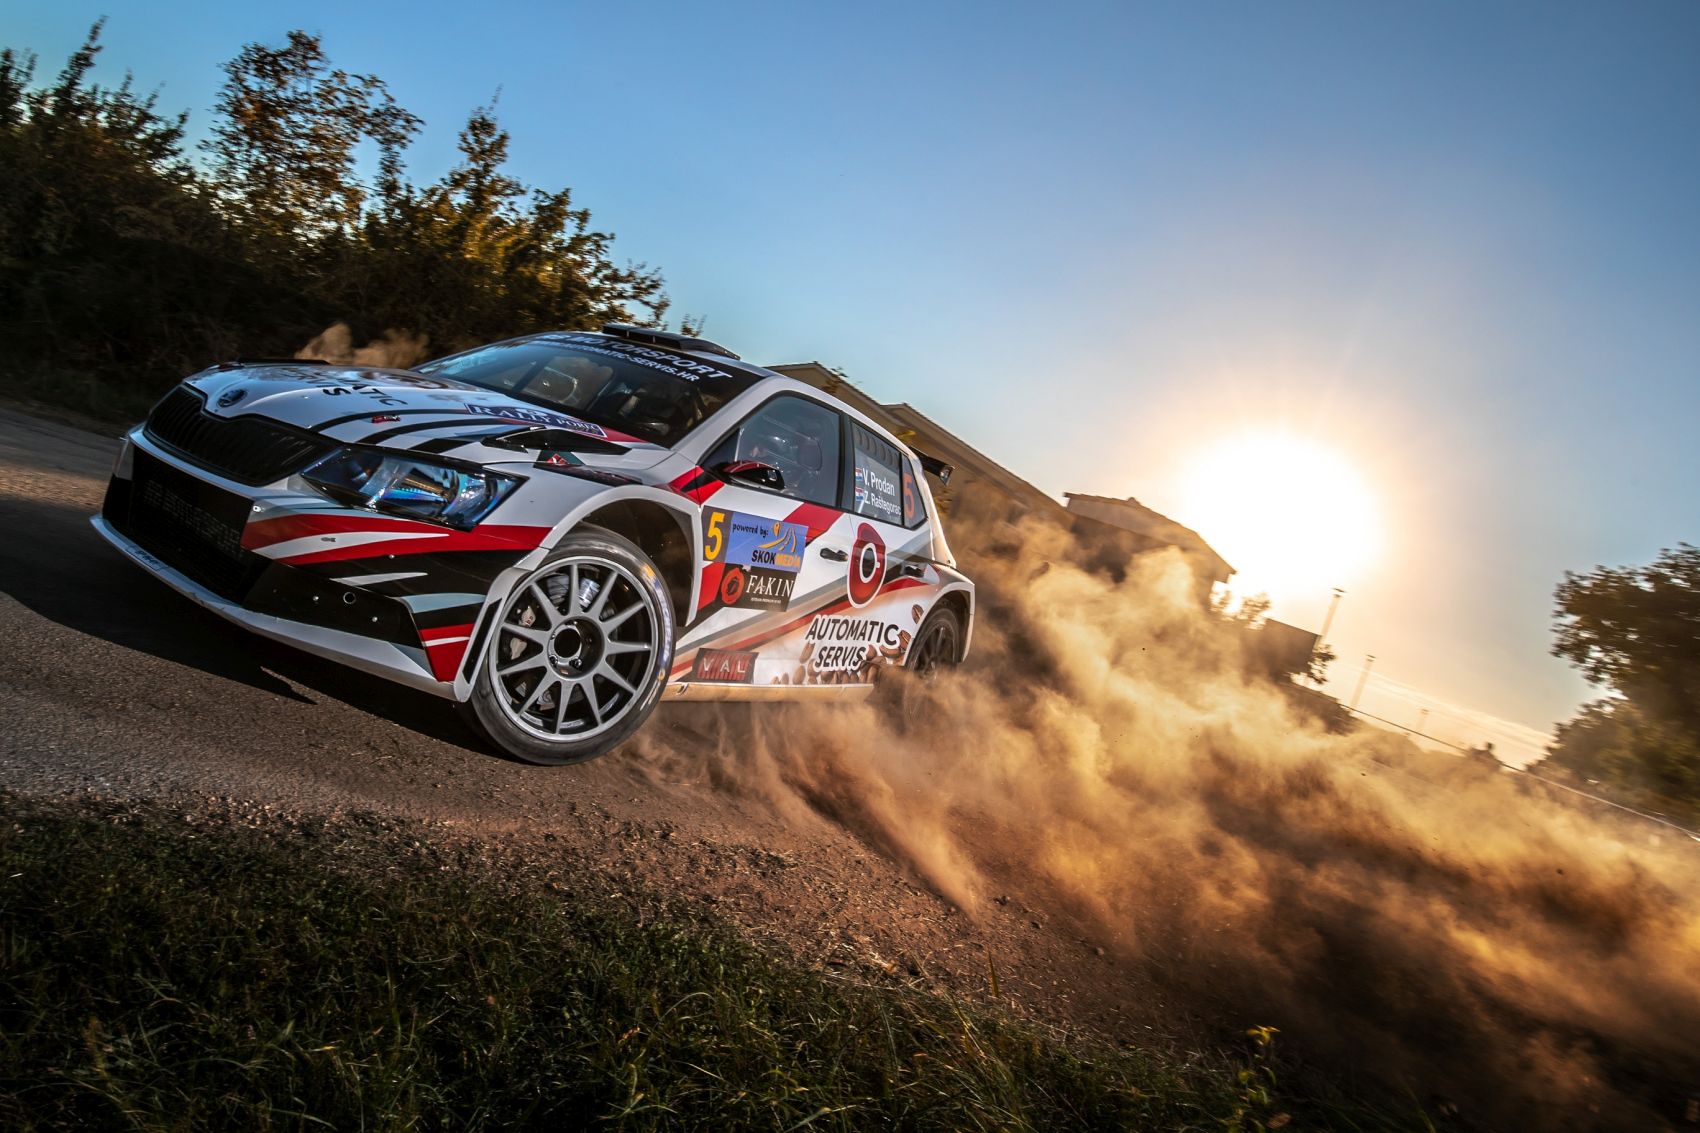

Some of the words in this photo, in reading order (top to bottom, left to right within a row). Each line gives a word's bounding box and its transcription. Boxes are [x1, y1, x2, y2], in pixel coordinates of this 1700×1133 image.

[473, 405, 551, 424] RALLY
[862, 467, 870, 487] V.
[870, 471, 896, 497] Prodan
[864, 490, 871, 505] Z.
[903, 473, 915, 520] 5
[704, 511, 725, 560] 5
[732, 523, 758, 534] powered
[759, 528, 769, 538] by:
[746, 574, 794, 598] FAKIN
[805, 618, 899, 645] AUTOMATIC
[703, 657, 746, 673] VAL
[815, 645, 867, 669] SERVIS
